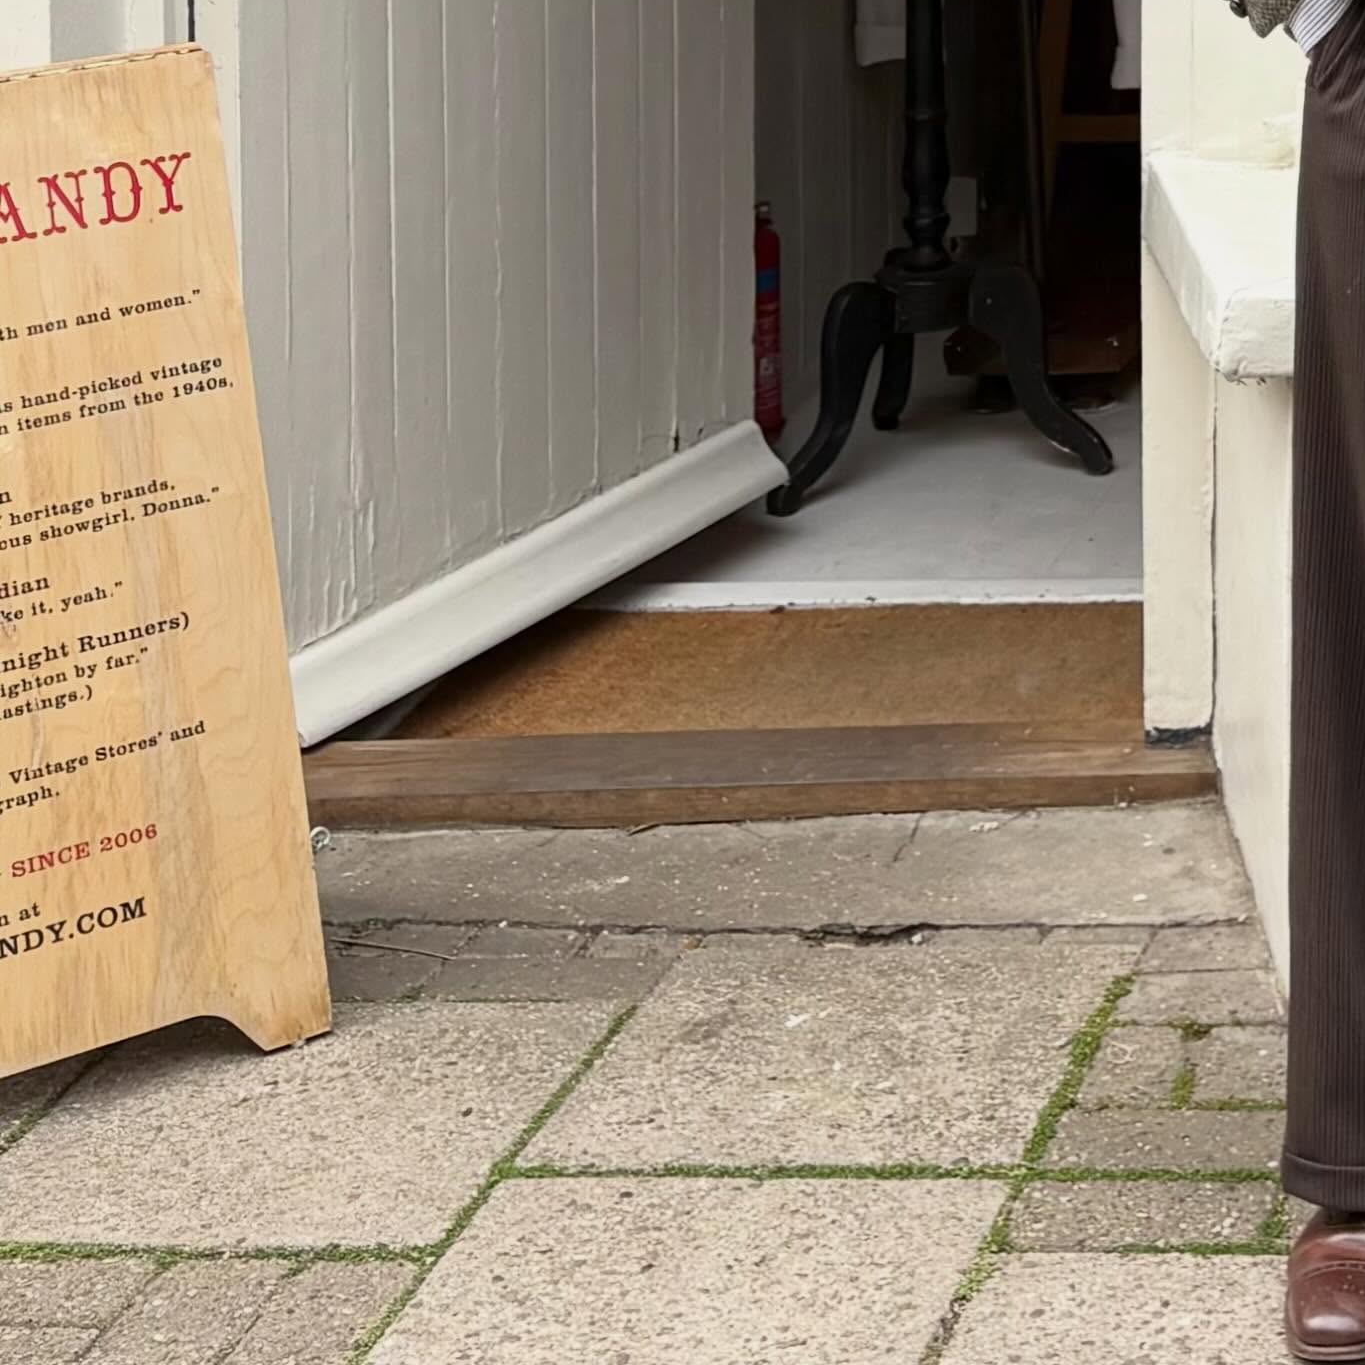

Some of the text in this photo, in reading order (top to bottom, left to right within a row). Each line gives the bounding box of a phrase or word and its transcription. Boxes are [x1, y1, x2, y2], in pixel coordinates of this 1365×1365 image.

[26, 320, 68, 337] men
[75, 307, 112, 326] and
[21, 372, 144, 410] hand-picked
[150, 356, 223, 381] vintage
[17, 411, 72, 432] items
[79, 398, 127, 418] from
[134, 389, 164, 407] the
[9, 497, 94, 526] heritage
[77, 611, 190, 654] Runners)
[74, 662, 98, 680] by
[9, 754, 89, 786] Vintage
[169, 720, 206, 742] and
[11, 823, 158, 878] SINCE 2006
[18, 900, 41, 921] at
